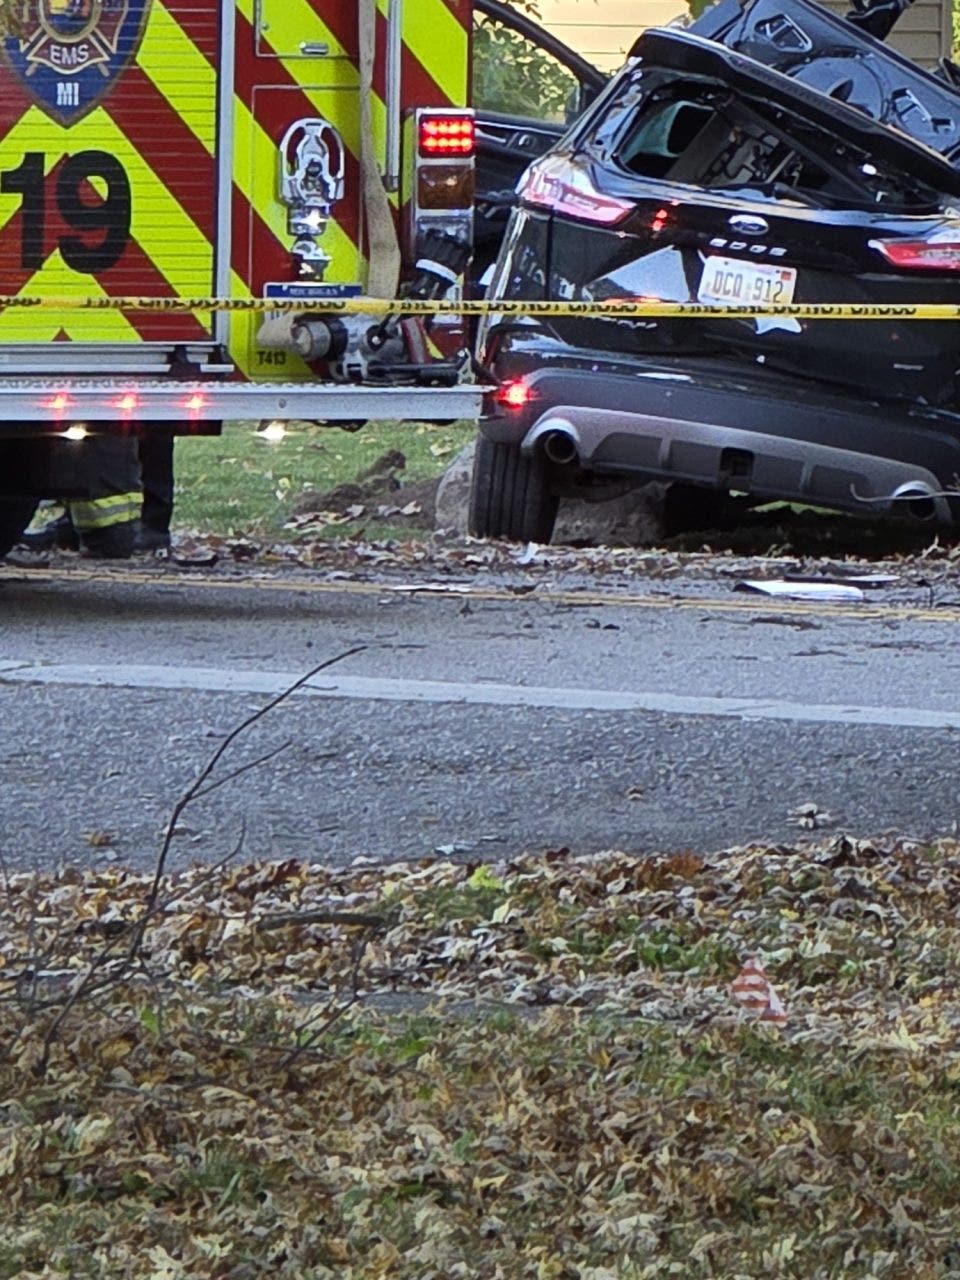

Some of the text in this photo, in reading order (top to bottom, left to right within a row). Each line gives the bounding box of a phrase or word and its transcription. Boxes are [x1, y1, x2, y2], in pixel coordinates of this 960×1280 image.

[50, 44, 90, 65] EMS
[56, 82, 80, 106] MI
[0, 149, 132, 274] 19
[752, 276, 785, 304] 912
[257, 351, 287, 365] T413
